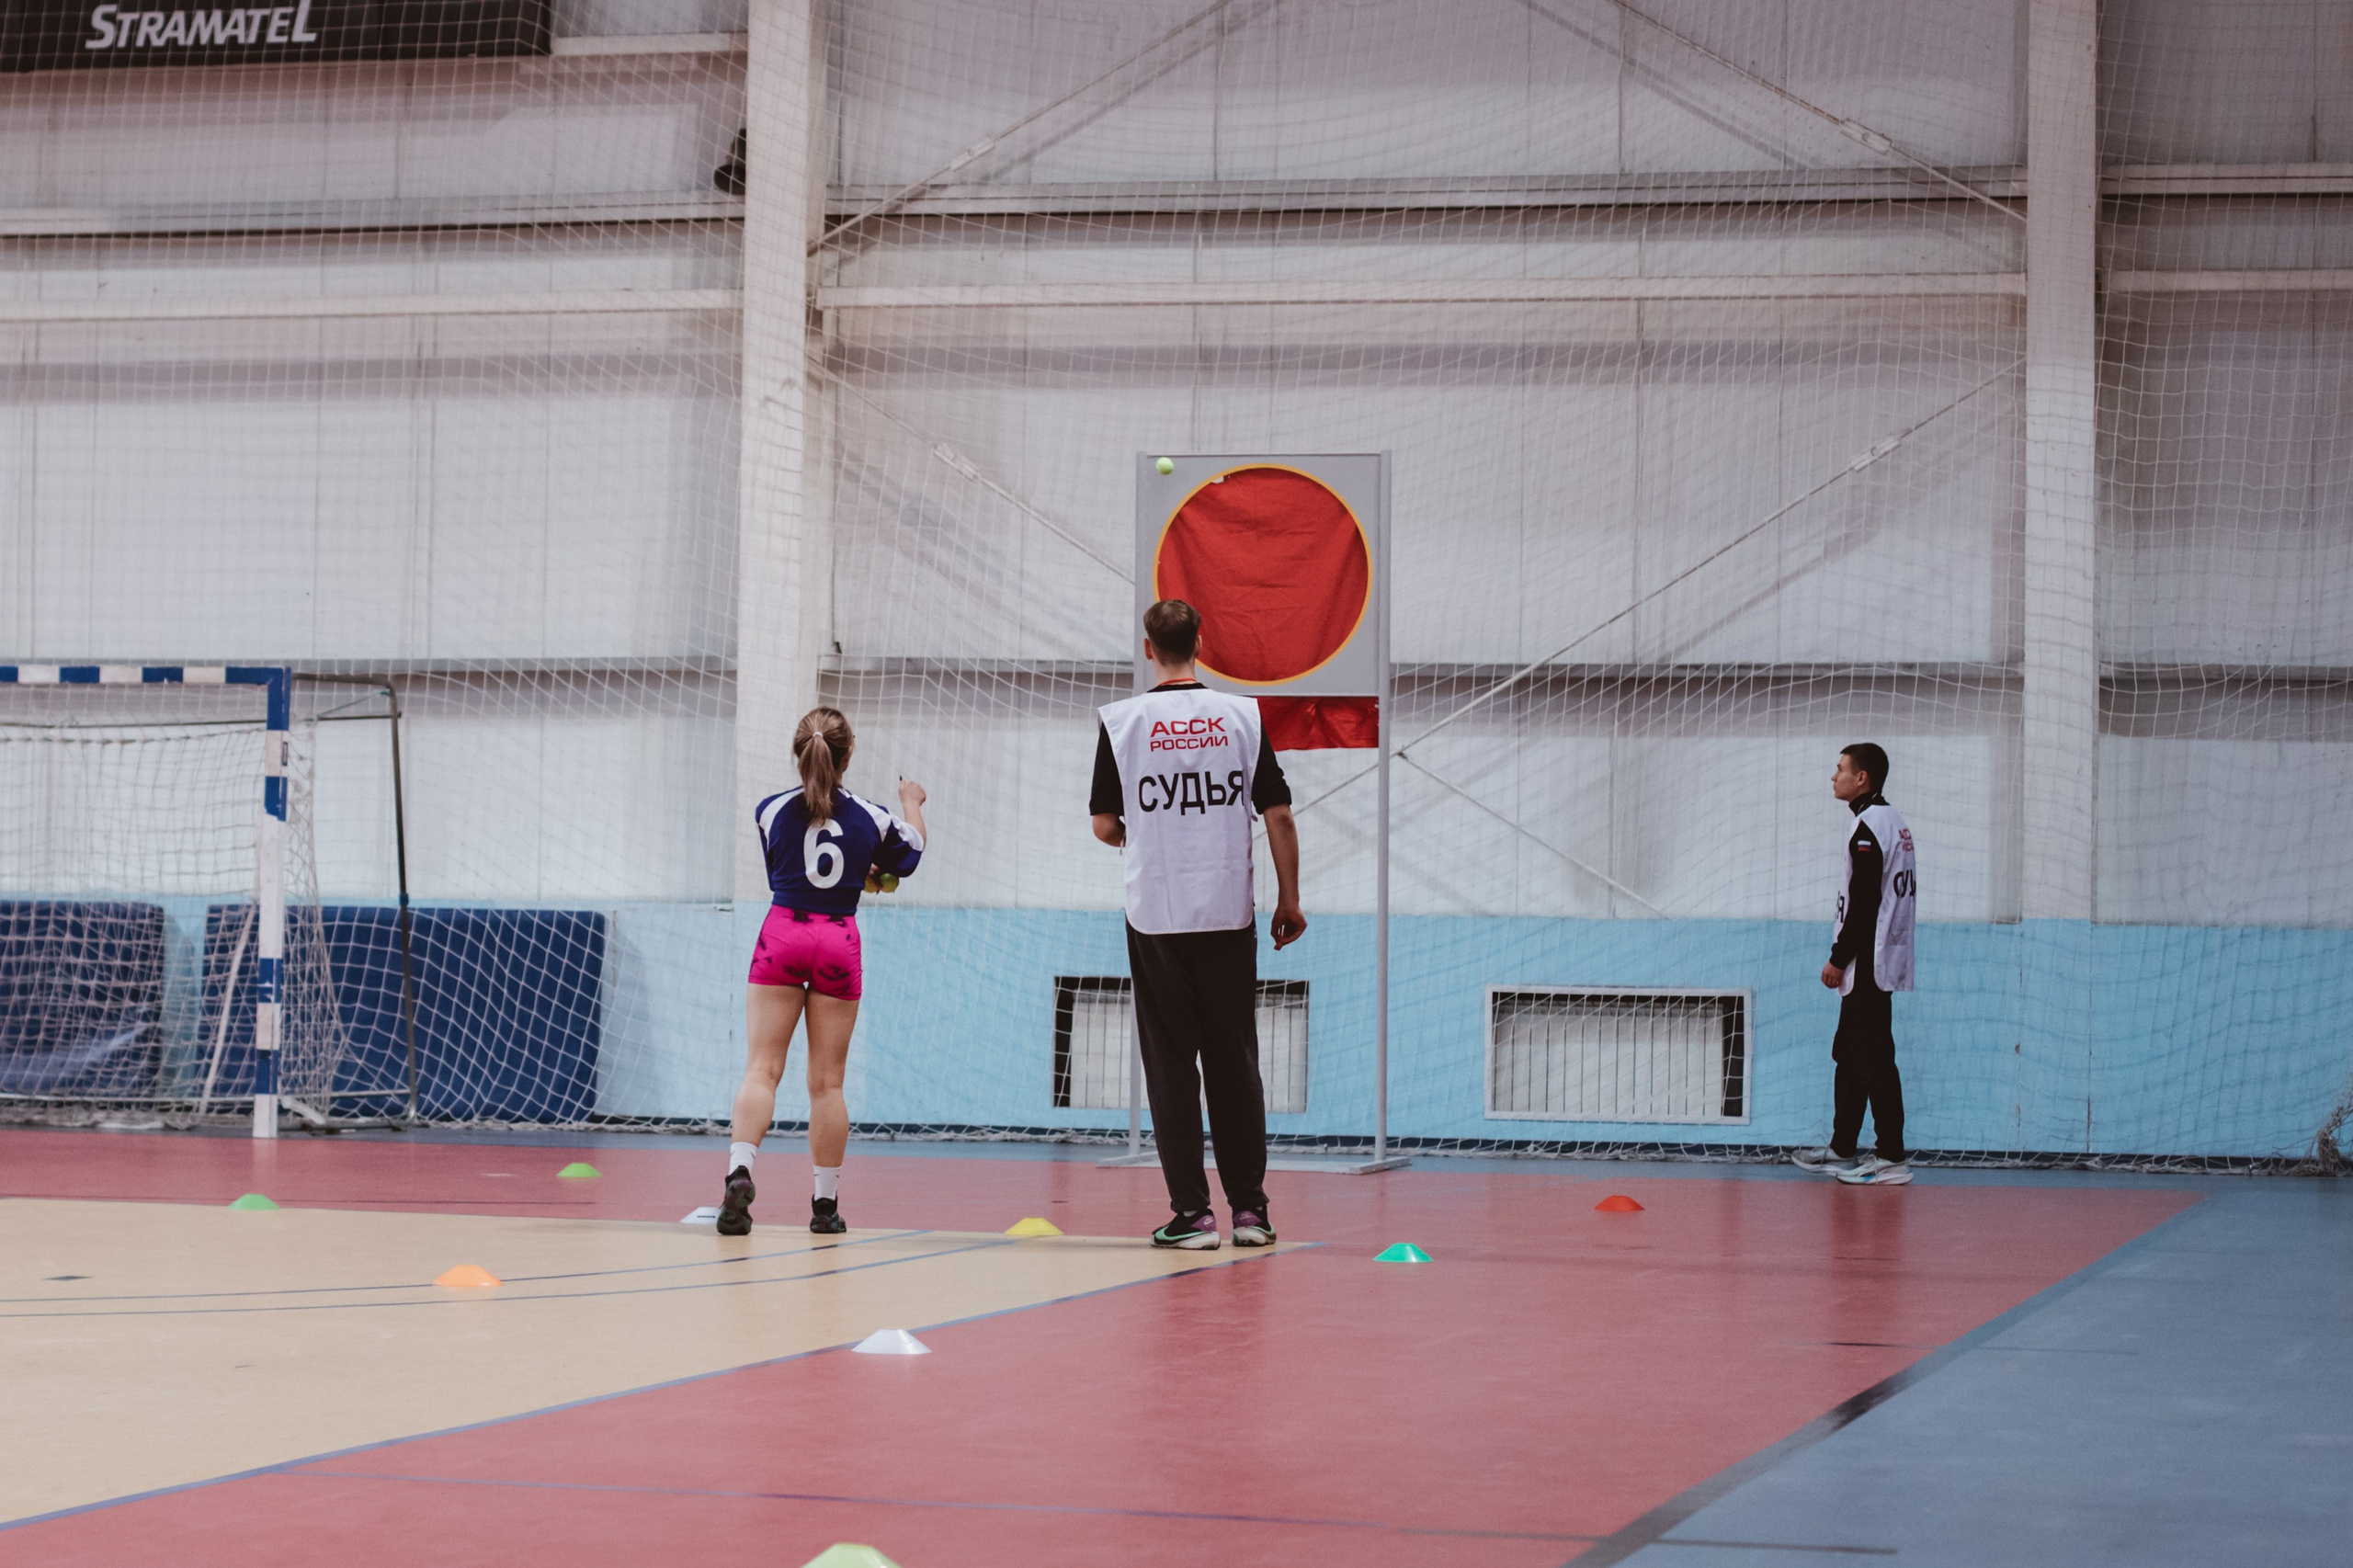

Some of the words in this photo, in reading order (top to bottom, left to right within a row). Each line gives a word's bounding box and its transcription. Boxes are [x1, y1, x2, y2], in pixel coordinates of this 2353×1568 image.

[85, 0, 317, 49] STRAMATEL
[1150, 717, 1226, 737] АССК
[1150, 735, 1228, 752] РОССИИ
[1139, 770, 1244, 816] СУДЬЯ
[803, 818, 845, 889] 6
